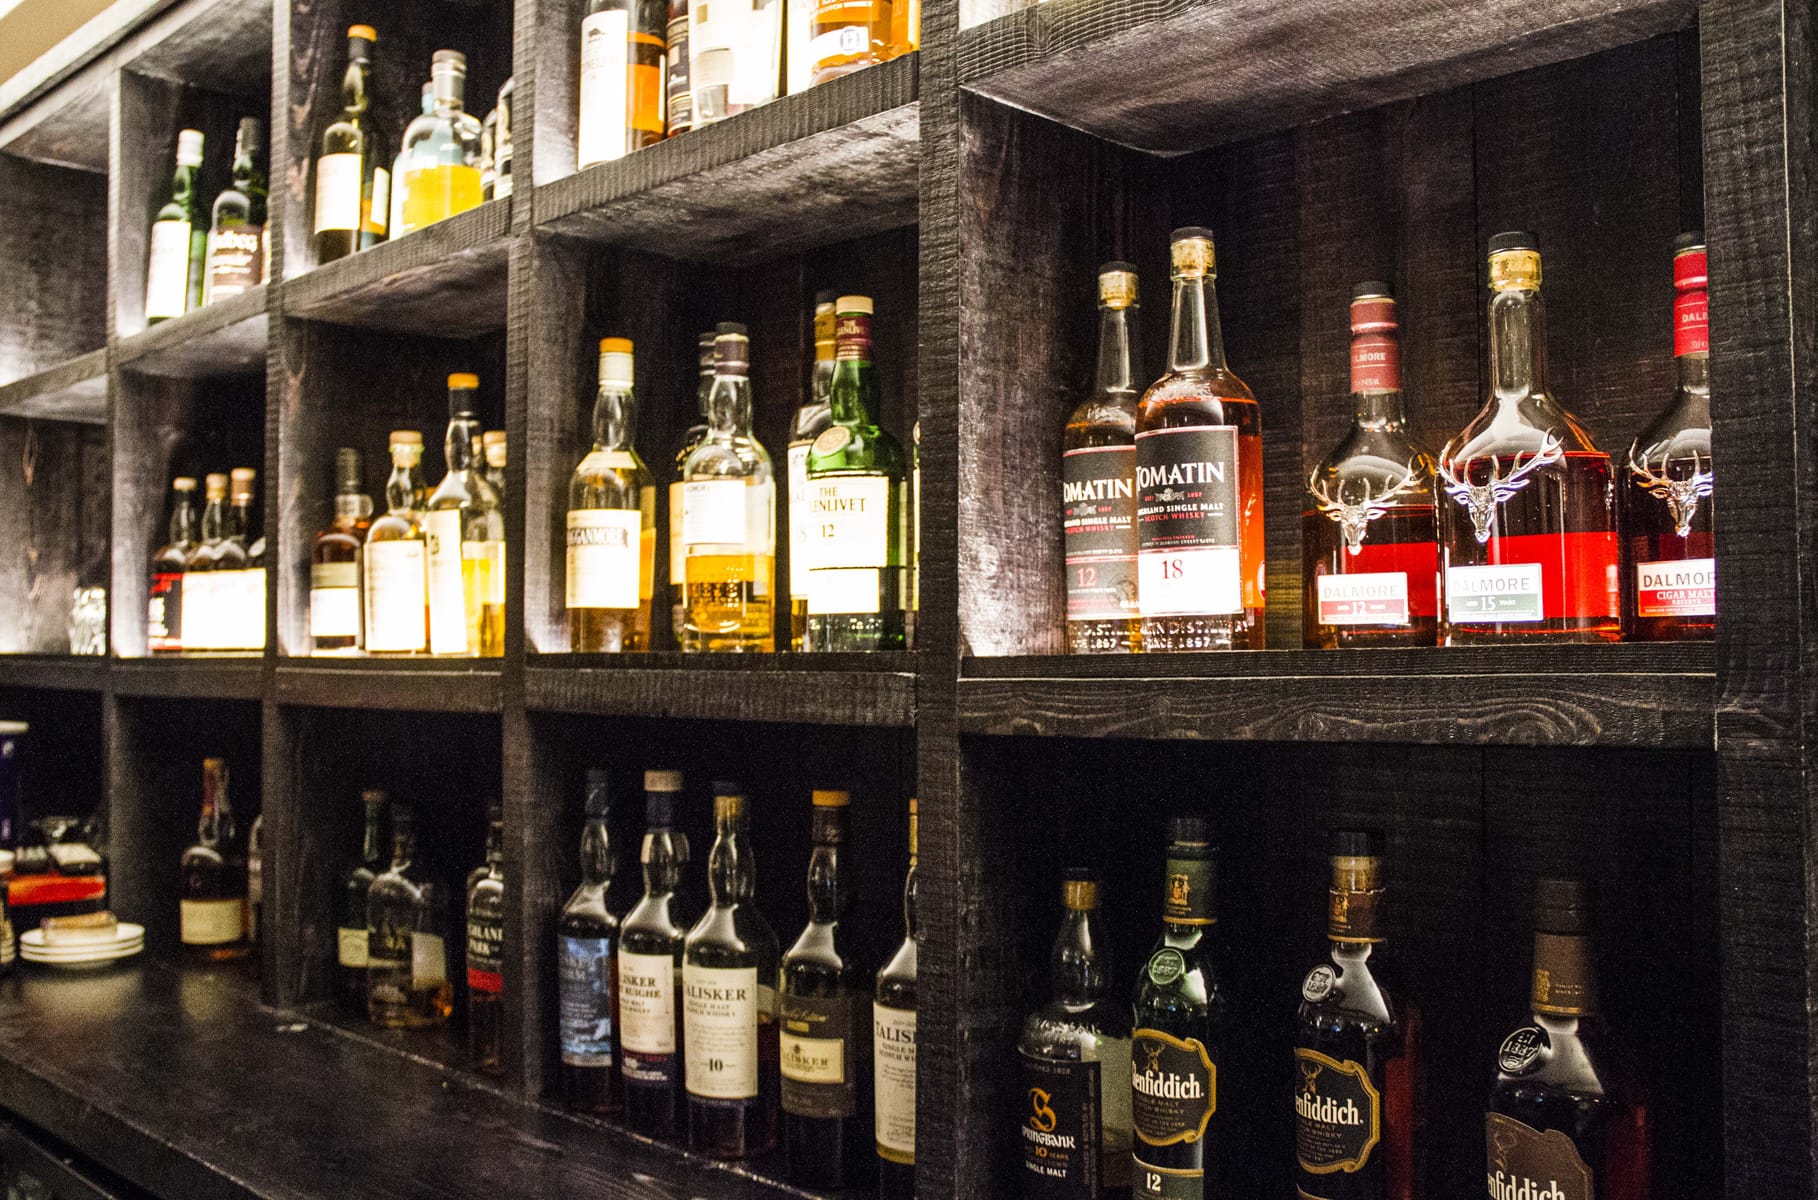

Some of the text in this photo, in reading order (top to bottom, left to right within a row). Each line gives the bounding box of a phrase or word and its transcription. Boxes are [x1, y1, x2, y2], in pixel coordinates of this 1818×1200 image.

[819, 485, 839, 497] THE
[1063, 478, 1133, 503] OMATIN
[1166, 503, 1198, 513] SINGLE
[1200, 502, 1224, 511] MALT
[1171, 511, 1206, 520] WHISKY
[821, 522, 835, 539] 12
[1161, 559, 1183, 579] 18
[1077, 567, 1097, 587] 12
[1323, 584, 1401, 599] DALMORE
[1454, 577, 1531, 593] DALMORE
[1657, 590, 1686, 600] CIGAR
[1352, 600, 1367, 616] 12
[1480, 596, 1496, 611] 15
[876, 1021, 916, 1044] TALIS
[708, 1058, 723, 1072] 10
[1035, 1145, 1048, 1158] 10
[1046, 1167, 1067, 1179] MALT
[1146, 1172, 1161, 1192] 12
